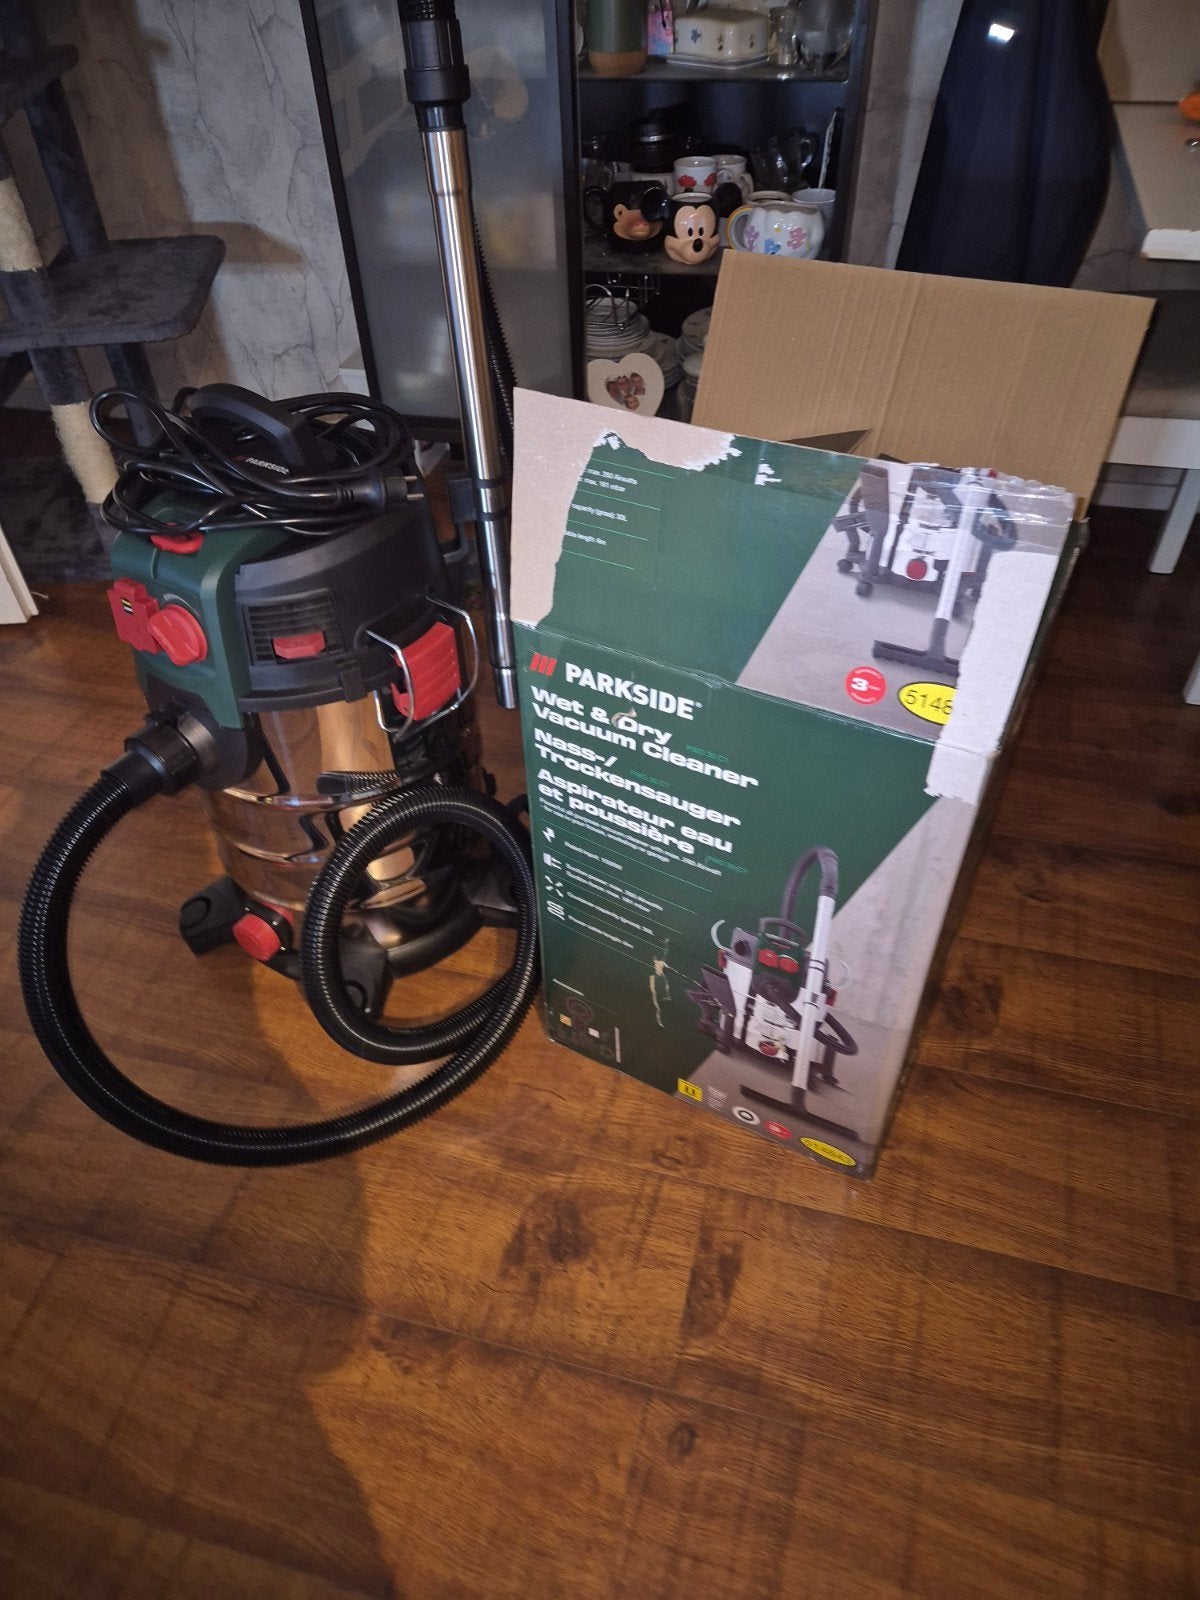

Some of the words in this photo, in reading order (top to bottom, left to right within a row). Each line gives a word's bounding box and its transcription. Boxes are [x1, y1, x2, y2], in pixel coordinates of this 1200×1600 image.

[530, 685, 585, 717] Wet
[590, 706, 611, 725] &
[617, 716, 673, 746] Dry
[565, 661, 694, 721] PARKSIDE
[850, 677, 870, 692] 3
[531, 702, 637, 751] Vacuum
[642, 741, 759, 788] Cleaner
[533, 727, 619, 768] Nass-/
[534, 742, 742, 827] Trockensauger
[537, 768, 676, 829] Aspirateur
[680, 824, 733, 854] eau
[537, 783, 564, 803] et
[568, 795, 695, 855] poussière
